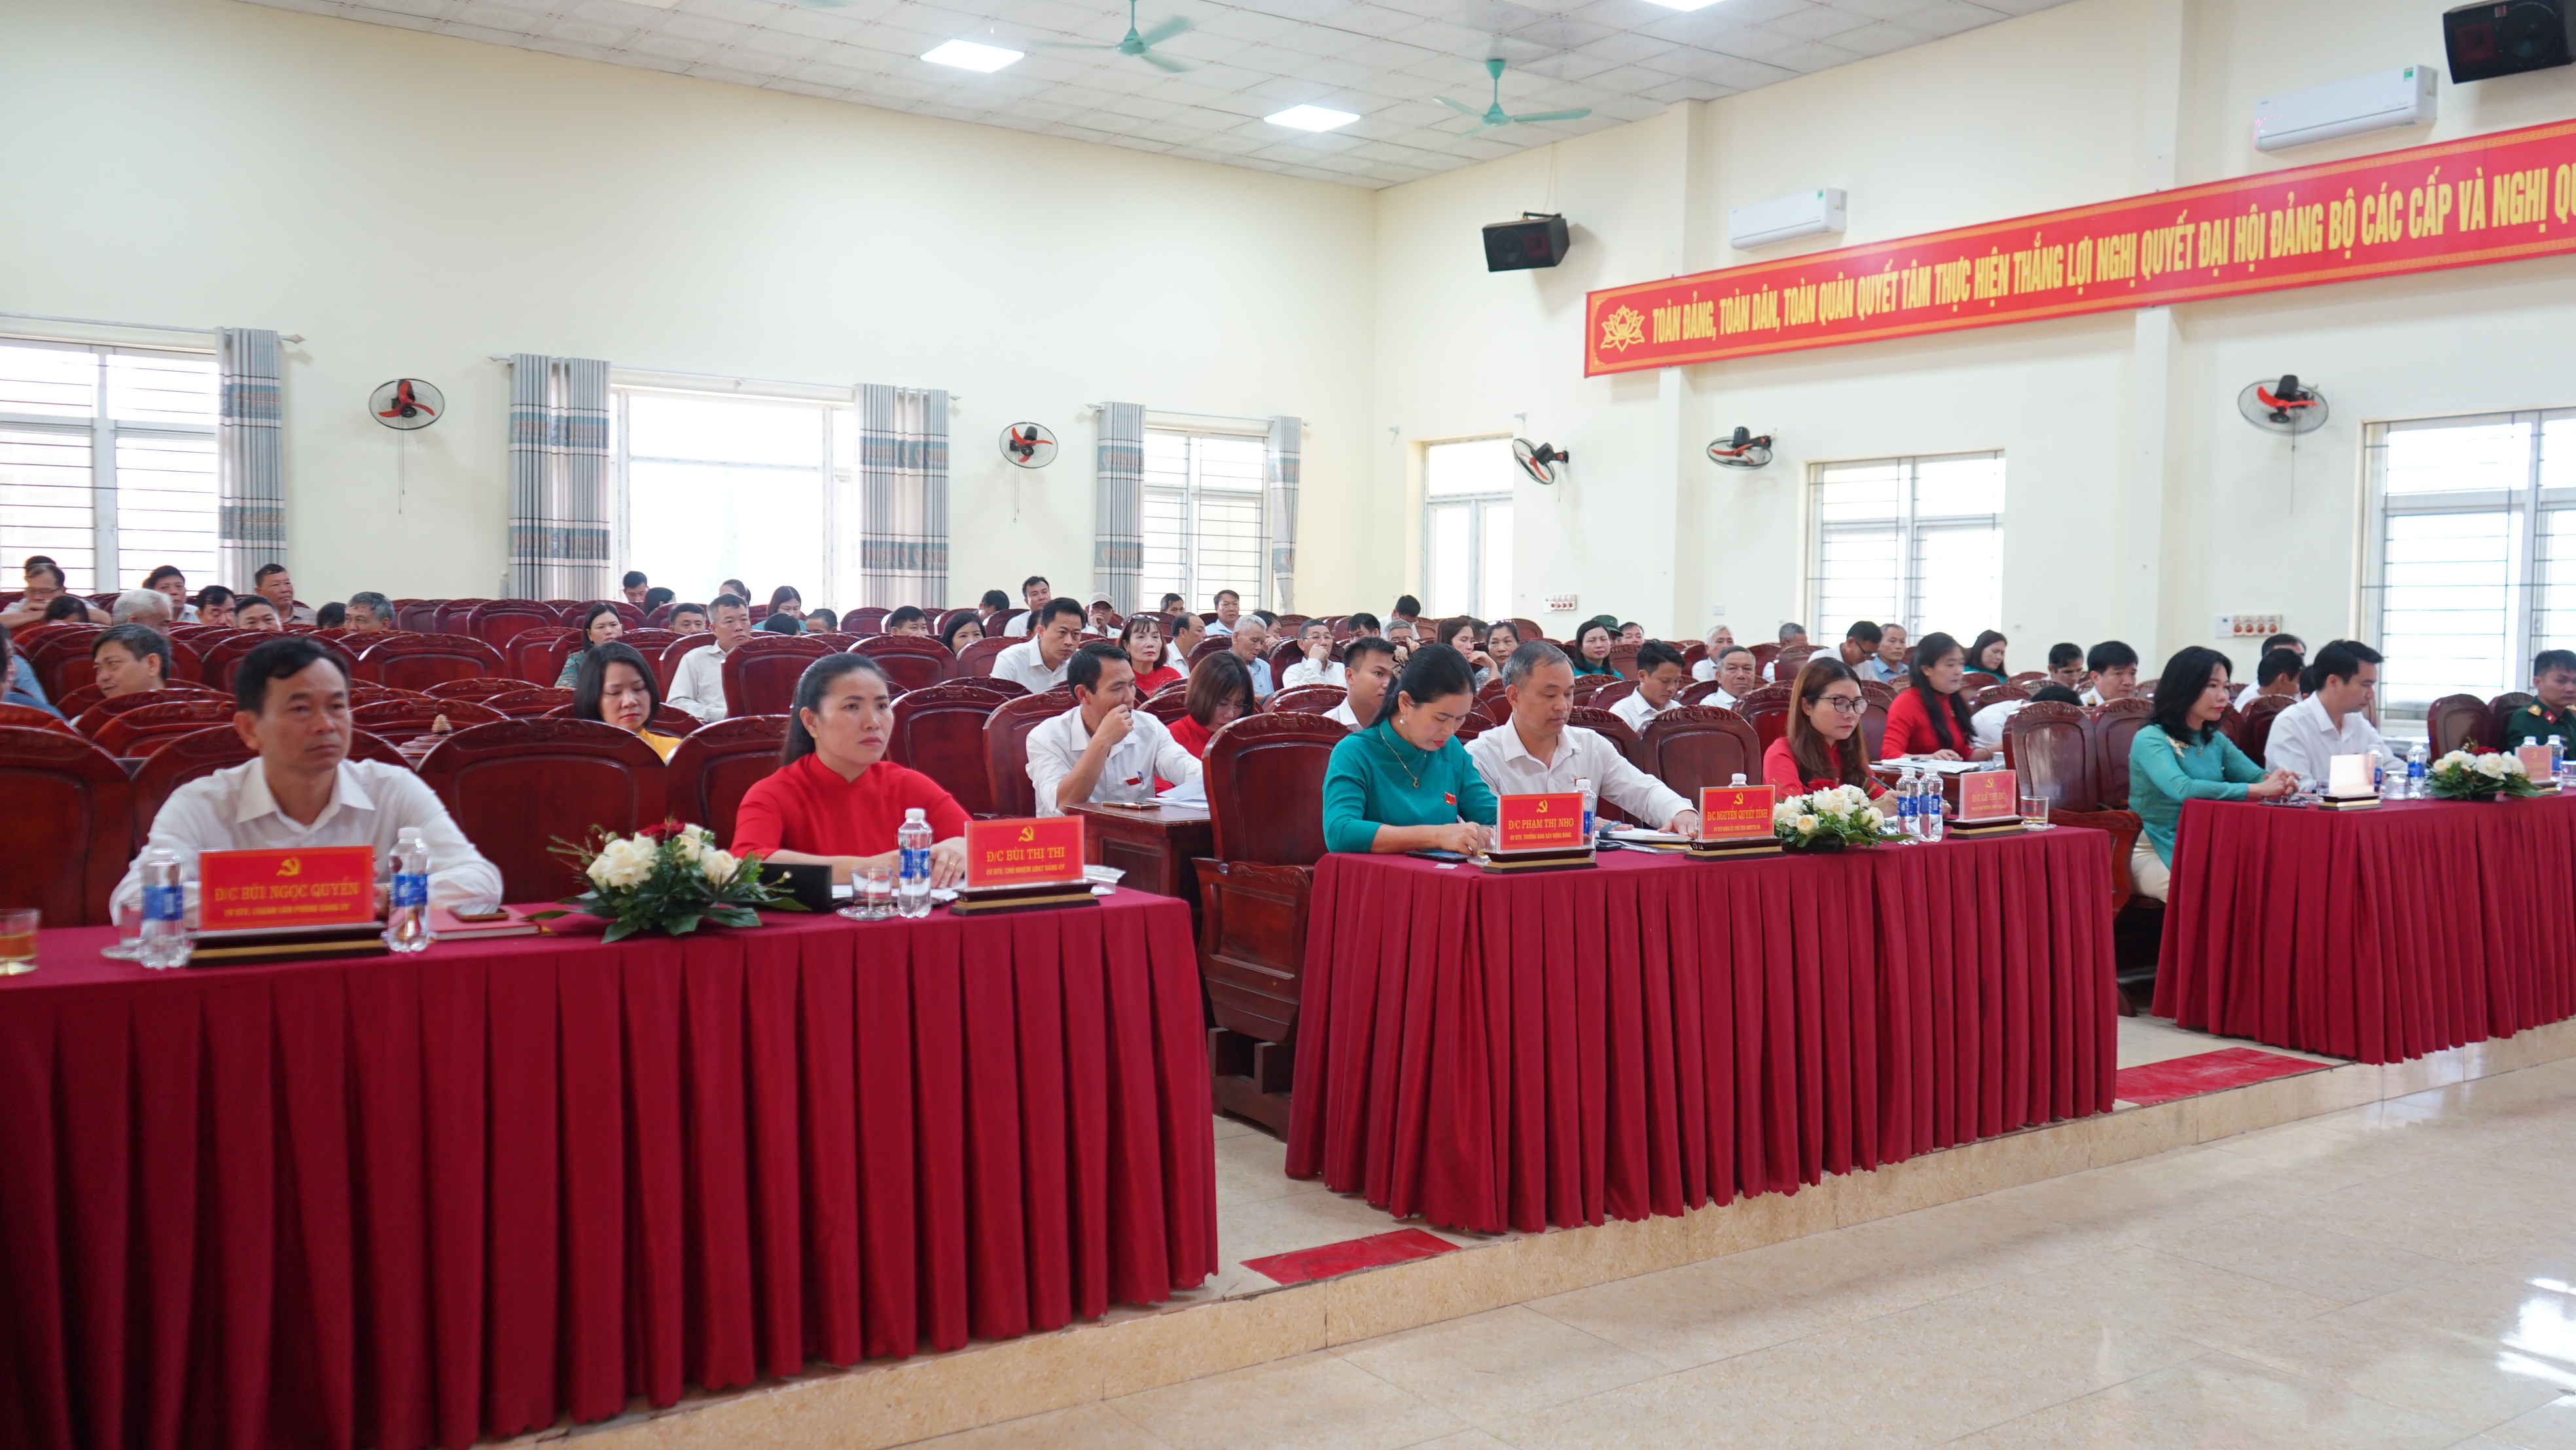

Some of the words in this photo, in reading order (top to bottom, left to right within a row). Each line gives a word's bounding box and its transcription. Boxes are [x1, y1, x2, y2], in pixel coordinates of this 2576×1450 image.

[1653, 299, 1681, 344] TOÀN
[1683, 291, 1716, 341] ĐẢNG,
[1719, 288, 1750, 335] TOÀN
[1752, 283, 1780, 332] DÂN,
[1783, 277, 1816, 326] TOÀN
[1818, 272, 1854, 326] QUÂN
[1857, 258, 1899, 321] QUYẾT
[1901, 258, 1931, 309] TÂM
[1934, 256, 1971, 312] THỰC
[1973, 246, 2010, 308] HIỆN
[2013, 231, 2064, 294] THẮNG
[2067, 235, 2093, 295] LỢI
[2096, 232, 2138, 288] NGHỊ
[2141, 209, 2196, 281] QUYẾT
[2198, 218, 2230, 277] ĐẠI
[2234, 203, 2266, 272] HỘI
[2270, 191, 2323, 258] ĐẢNG
[2328, 187, 2356, 260] BỘ
[2361, 181, 2403, 246] CÁC
[2408, 166, 2453, 239] CẤP
[2458, 166, 2486, 232] VÀ
[2492, 167, 2549, 233] NGHỊ
[1509, 820, 1520, 830] Đ/C
[1522, 819, 1543, 830] PHẠM
[1545, 819, 1556, 830] THỊ
[1558, 818, 1574, 827] NHO
[986, 850, 1004, 862] Đ/C
[1006, 847, 1024, 861] BÙI
[1027, 848, 1045, 862] THỊ
[1047, 847, 1065, 858] THI
[270, 884, 307, 902] NGỌC
